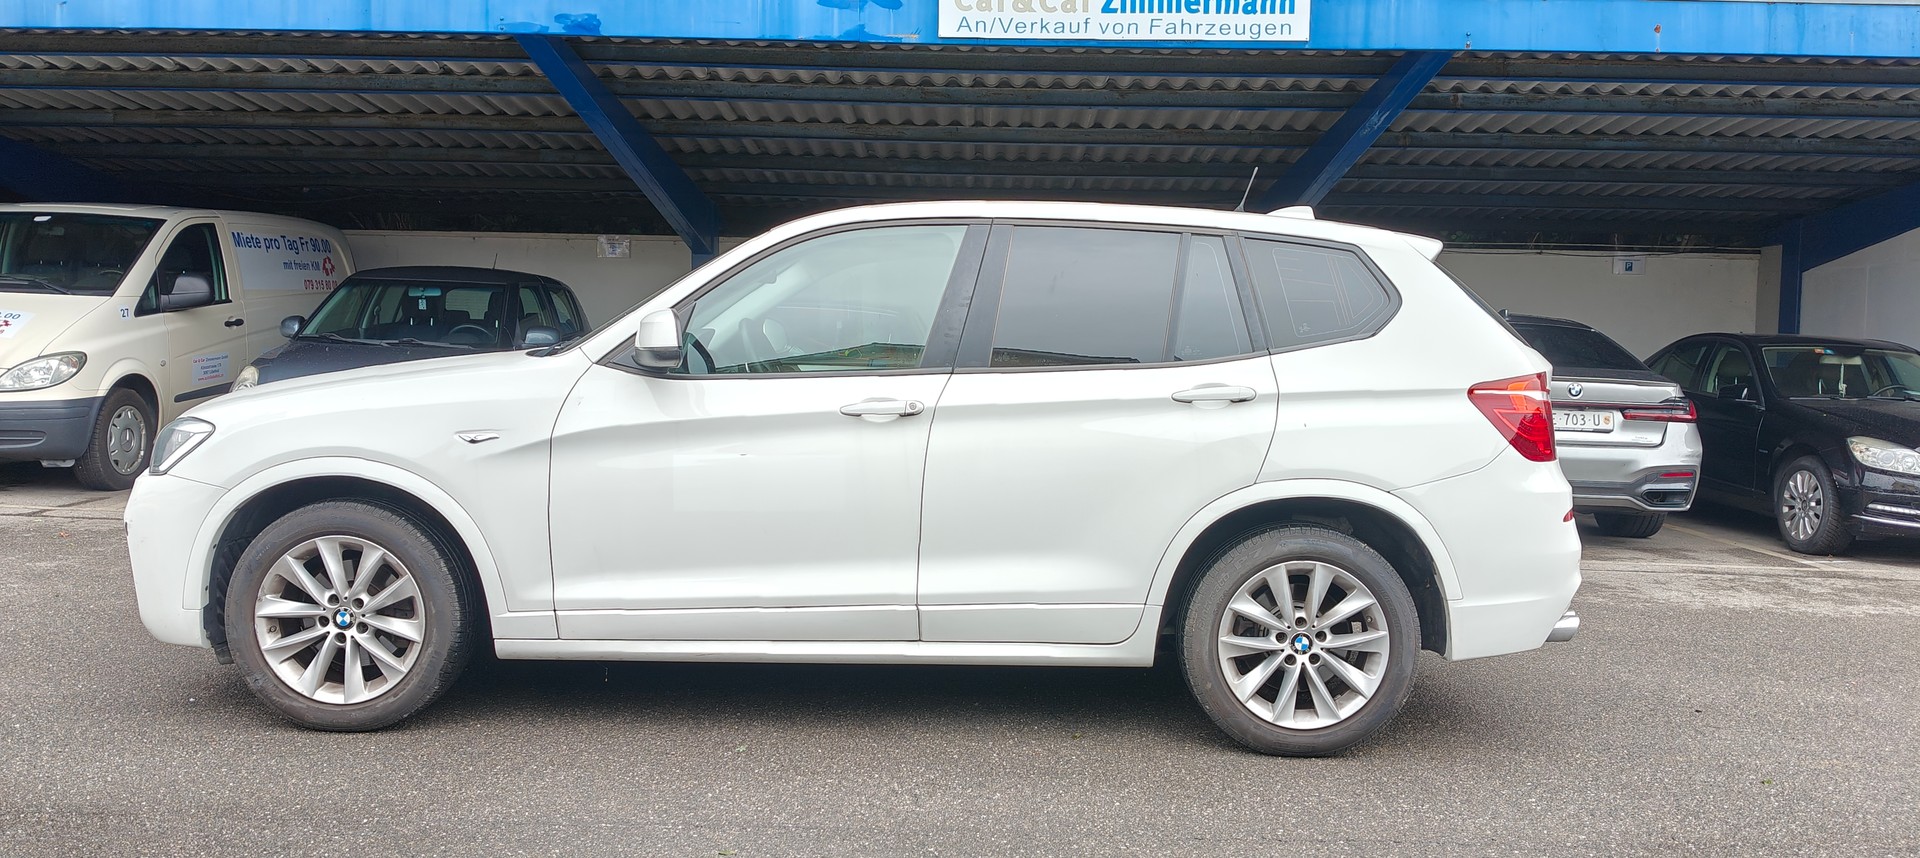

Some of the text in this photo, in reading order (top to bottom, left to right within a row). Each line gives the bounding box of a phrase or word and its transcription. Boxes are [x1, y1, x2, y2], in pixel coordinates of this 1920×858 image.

[1100, 0, 1295, 15] Zimmermann
[956, 16, 1292, 39] An/Verkauf von Fahrzeugen
[231, 231, 332, 255] Miete pro Tag Fr 90.00
[283, 259, 293, 270] mit
[293, 259, 311, 271] freien
[120, 308, 129, 318] 27
